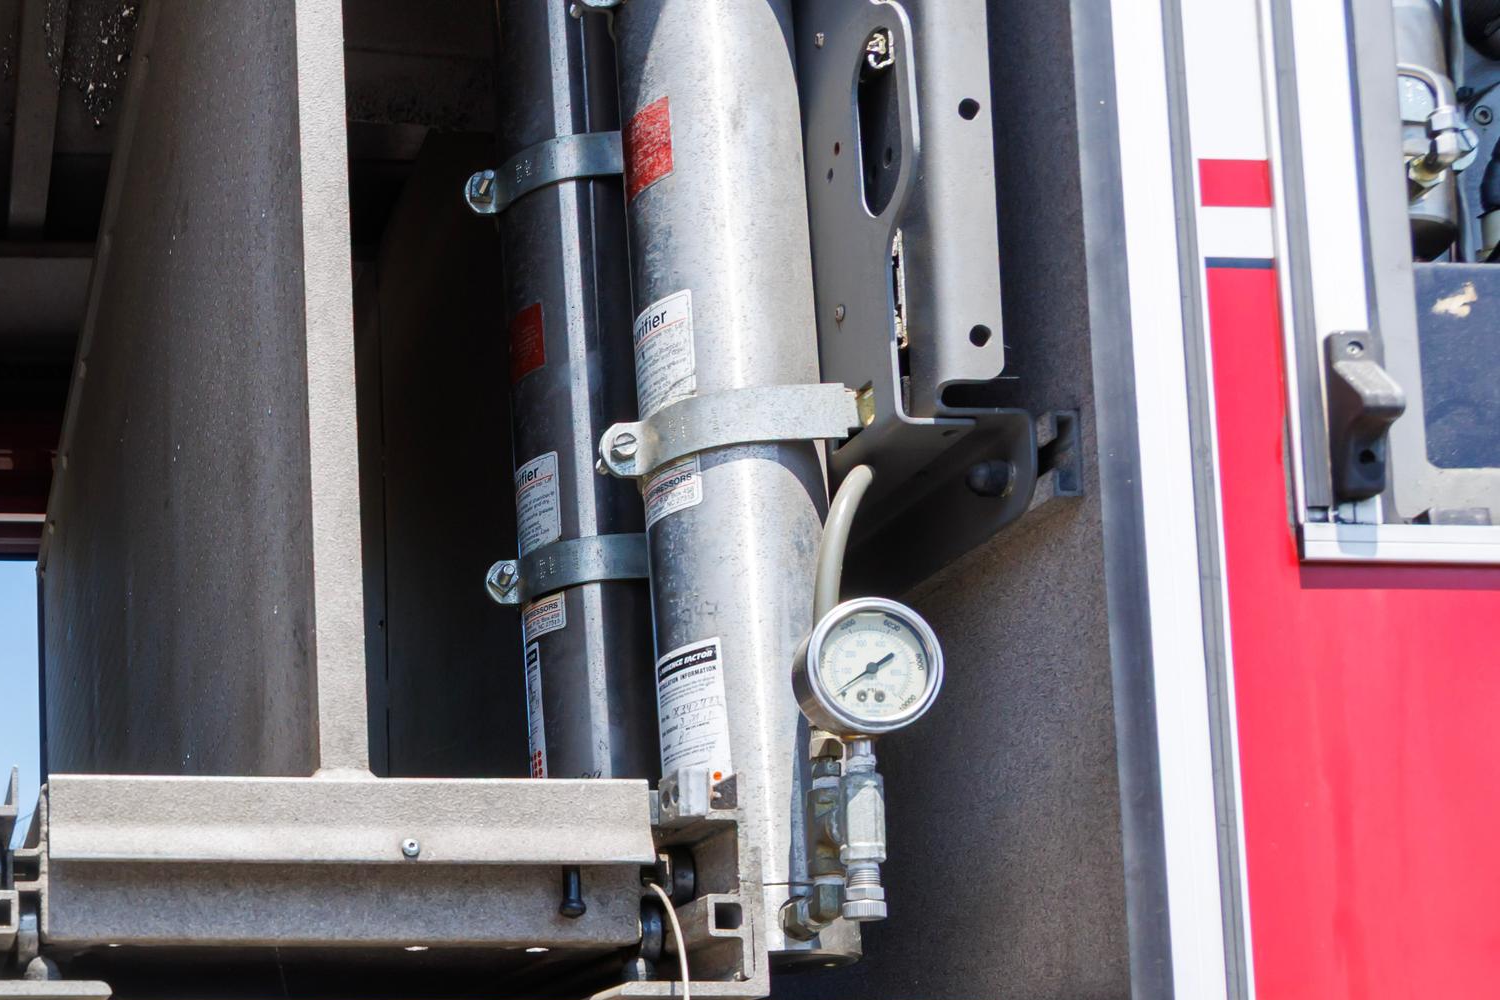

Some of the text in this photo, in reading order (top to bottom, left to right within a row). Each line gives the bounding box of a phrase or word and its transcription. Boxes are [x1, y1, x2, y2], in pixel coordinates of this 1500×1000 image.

[634, 310, 667, 346] urifier
[684, 649, 713, 664] FACTOR
[680, 664, 717, 681] INFORMATION
